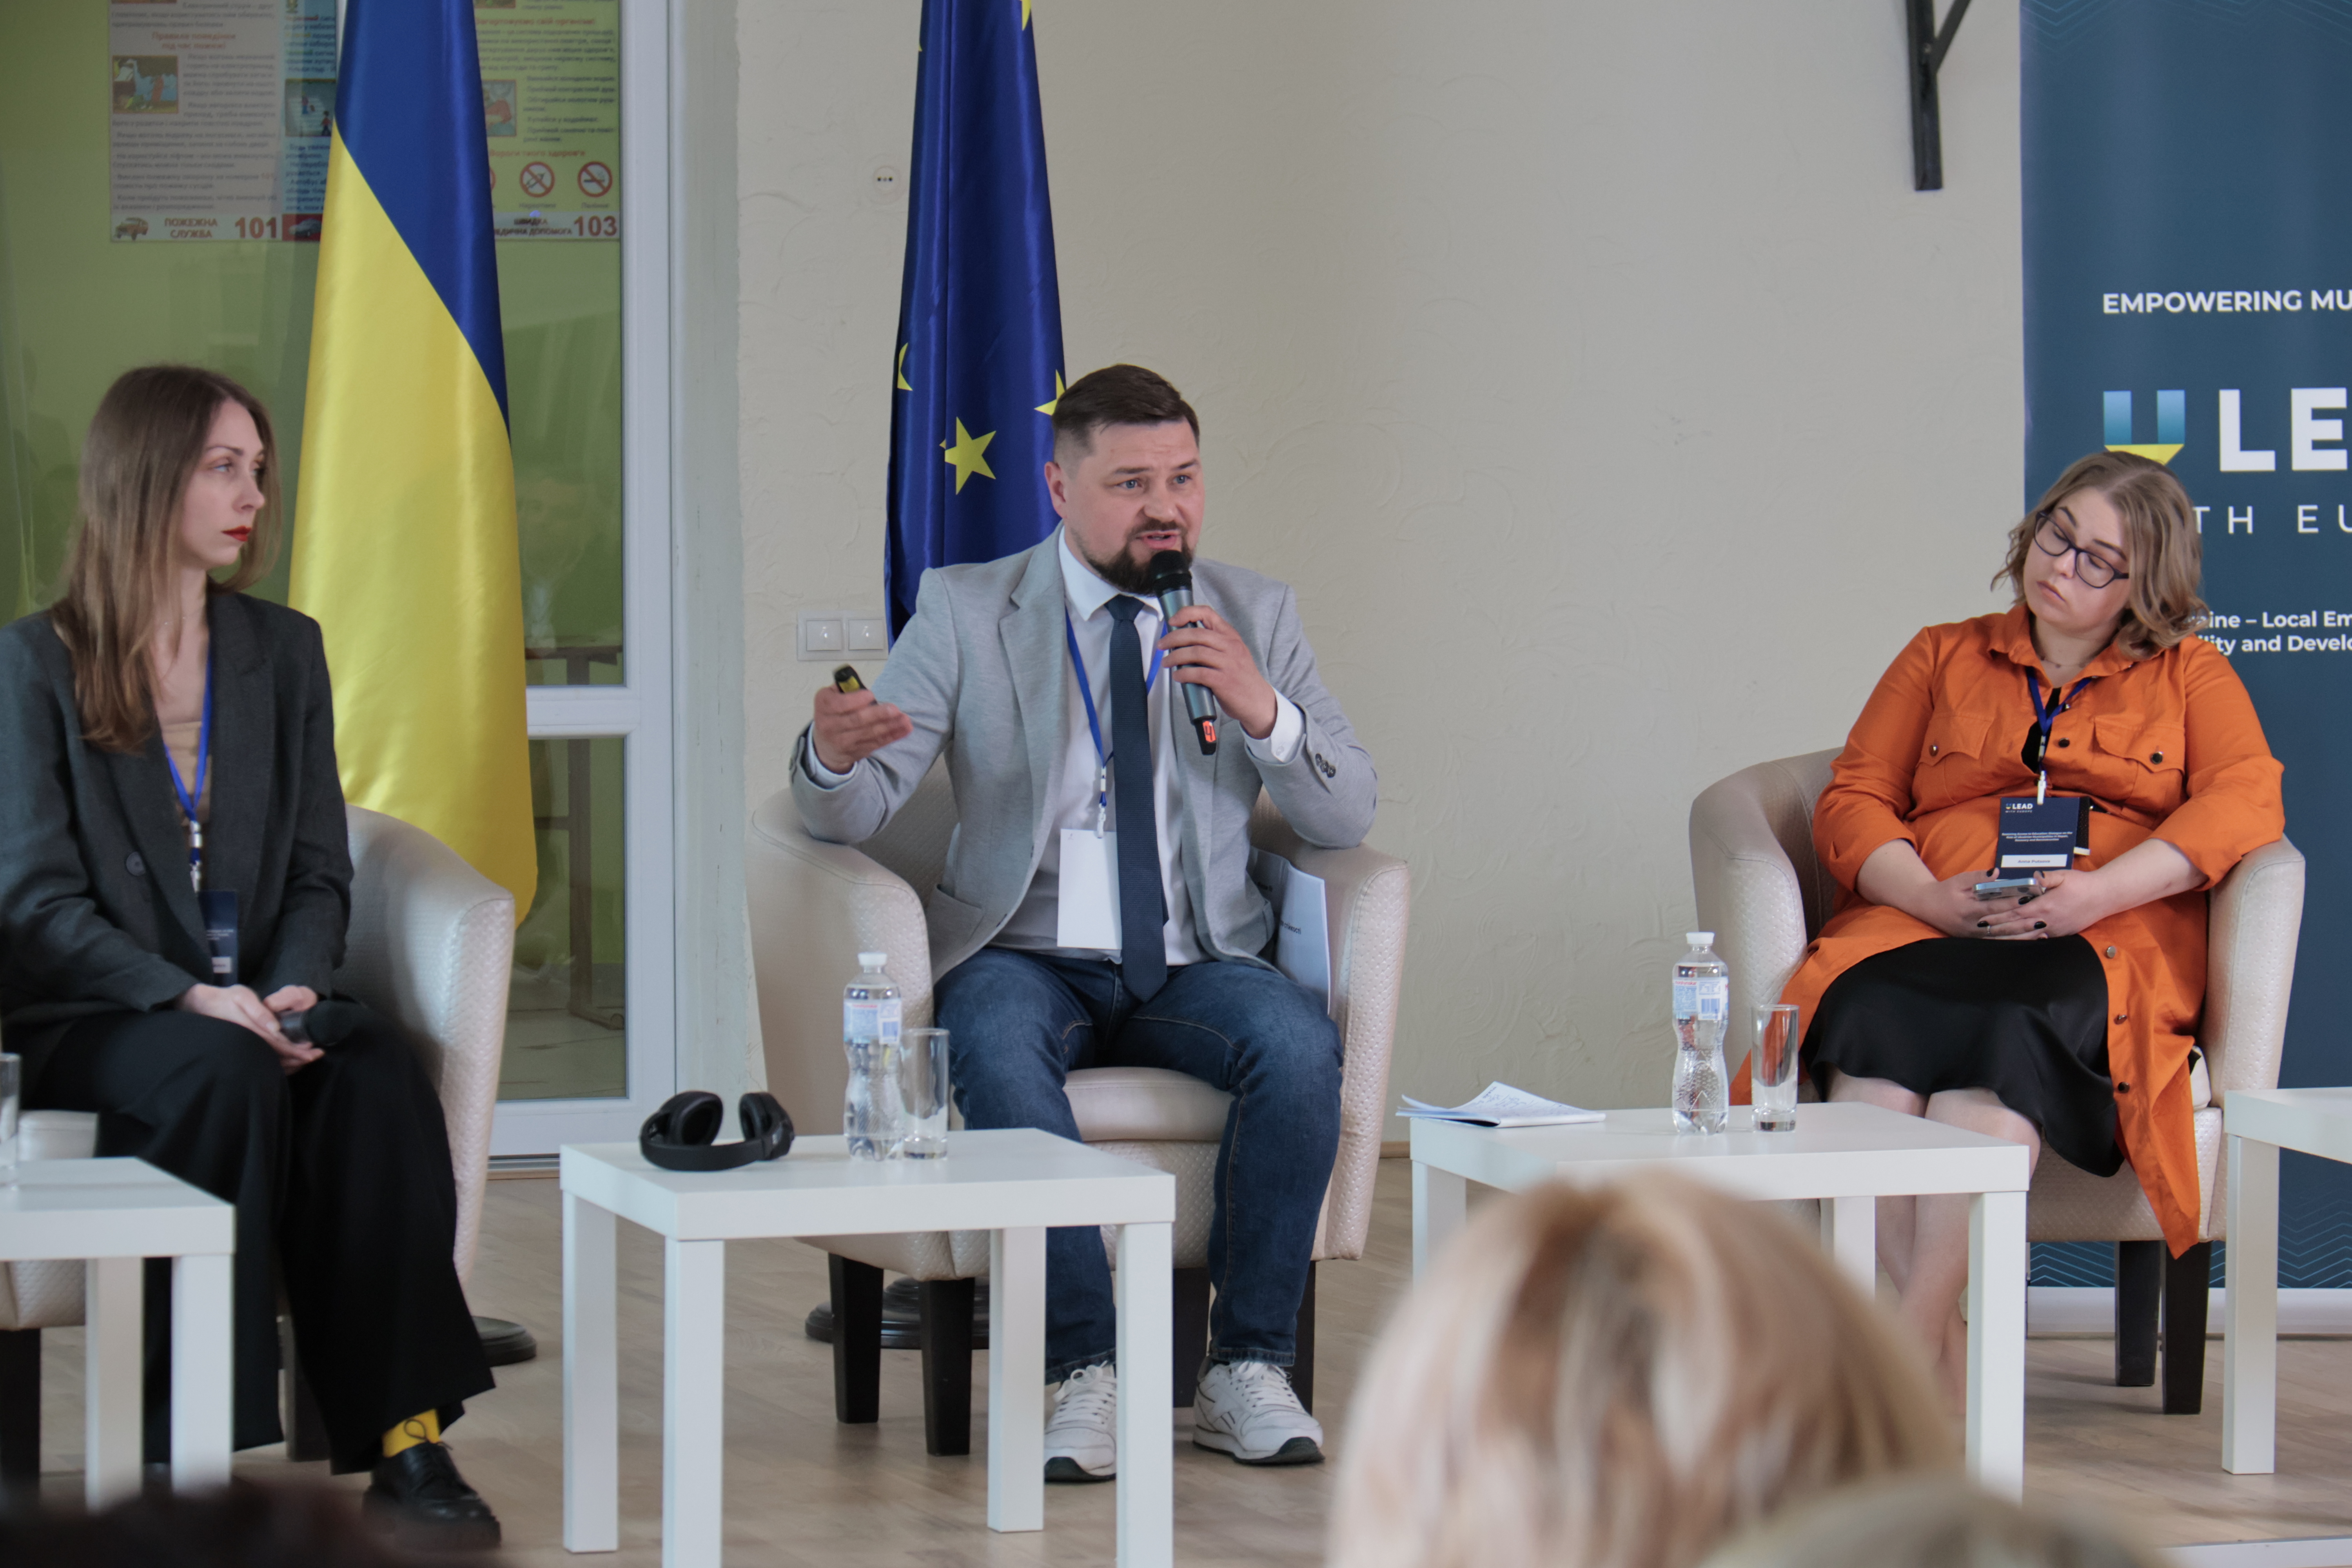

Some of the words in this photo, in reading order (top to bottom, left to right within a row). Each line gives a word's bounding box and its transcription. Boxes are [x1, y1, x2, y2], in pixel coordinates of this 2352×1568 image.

[164, 218, 218, 227] ПОЖЕЖНА
[235, 217, 277, 239] 101
[574, 216, 617, 237] 103
[170, 229, 212, 238] СЛУЖБА
[529, 228, 572, 237] ДОПОМОГА
[2103, 290, 2302, 313] EMPOWERING
[2311, 289, 2352, 311] MU
[2200, 611, 2241, 628] ine
[2262, 610, 2317, 628] Local
[2241, 635, 2281, 652] and
